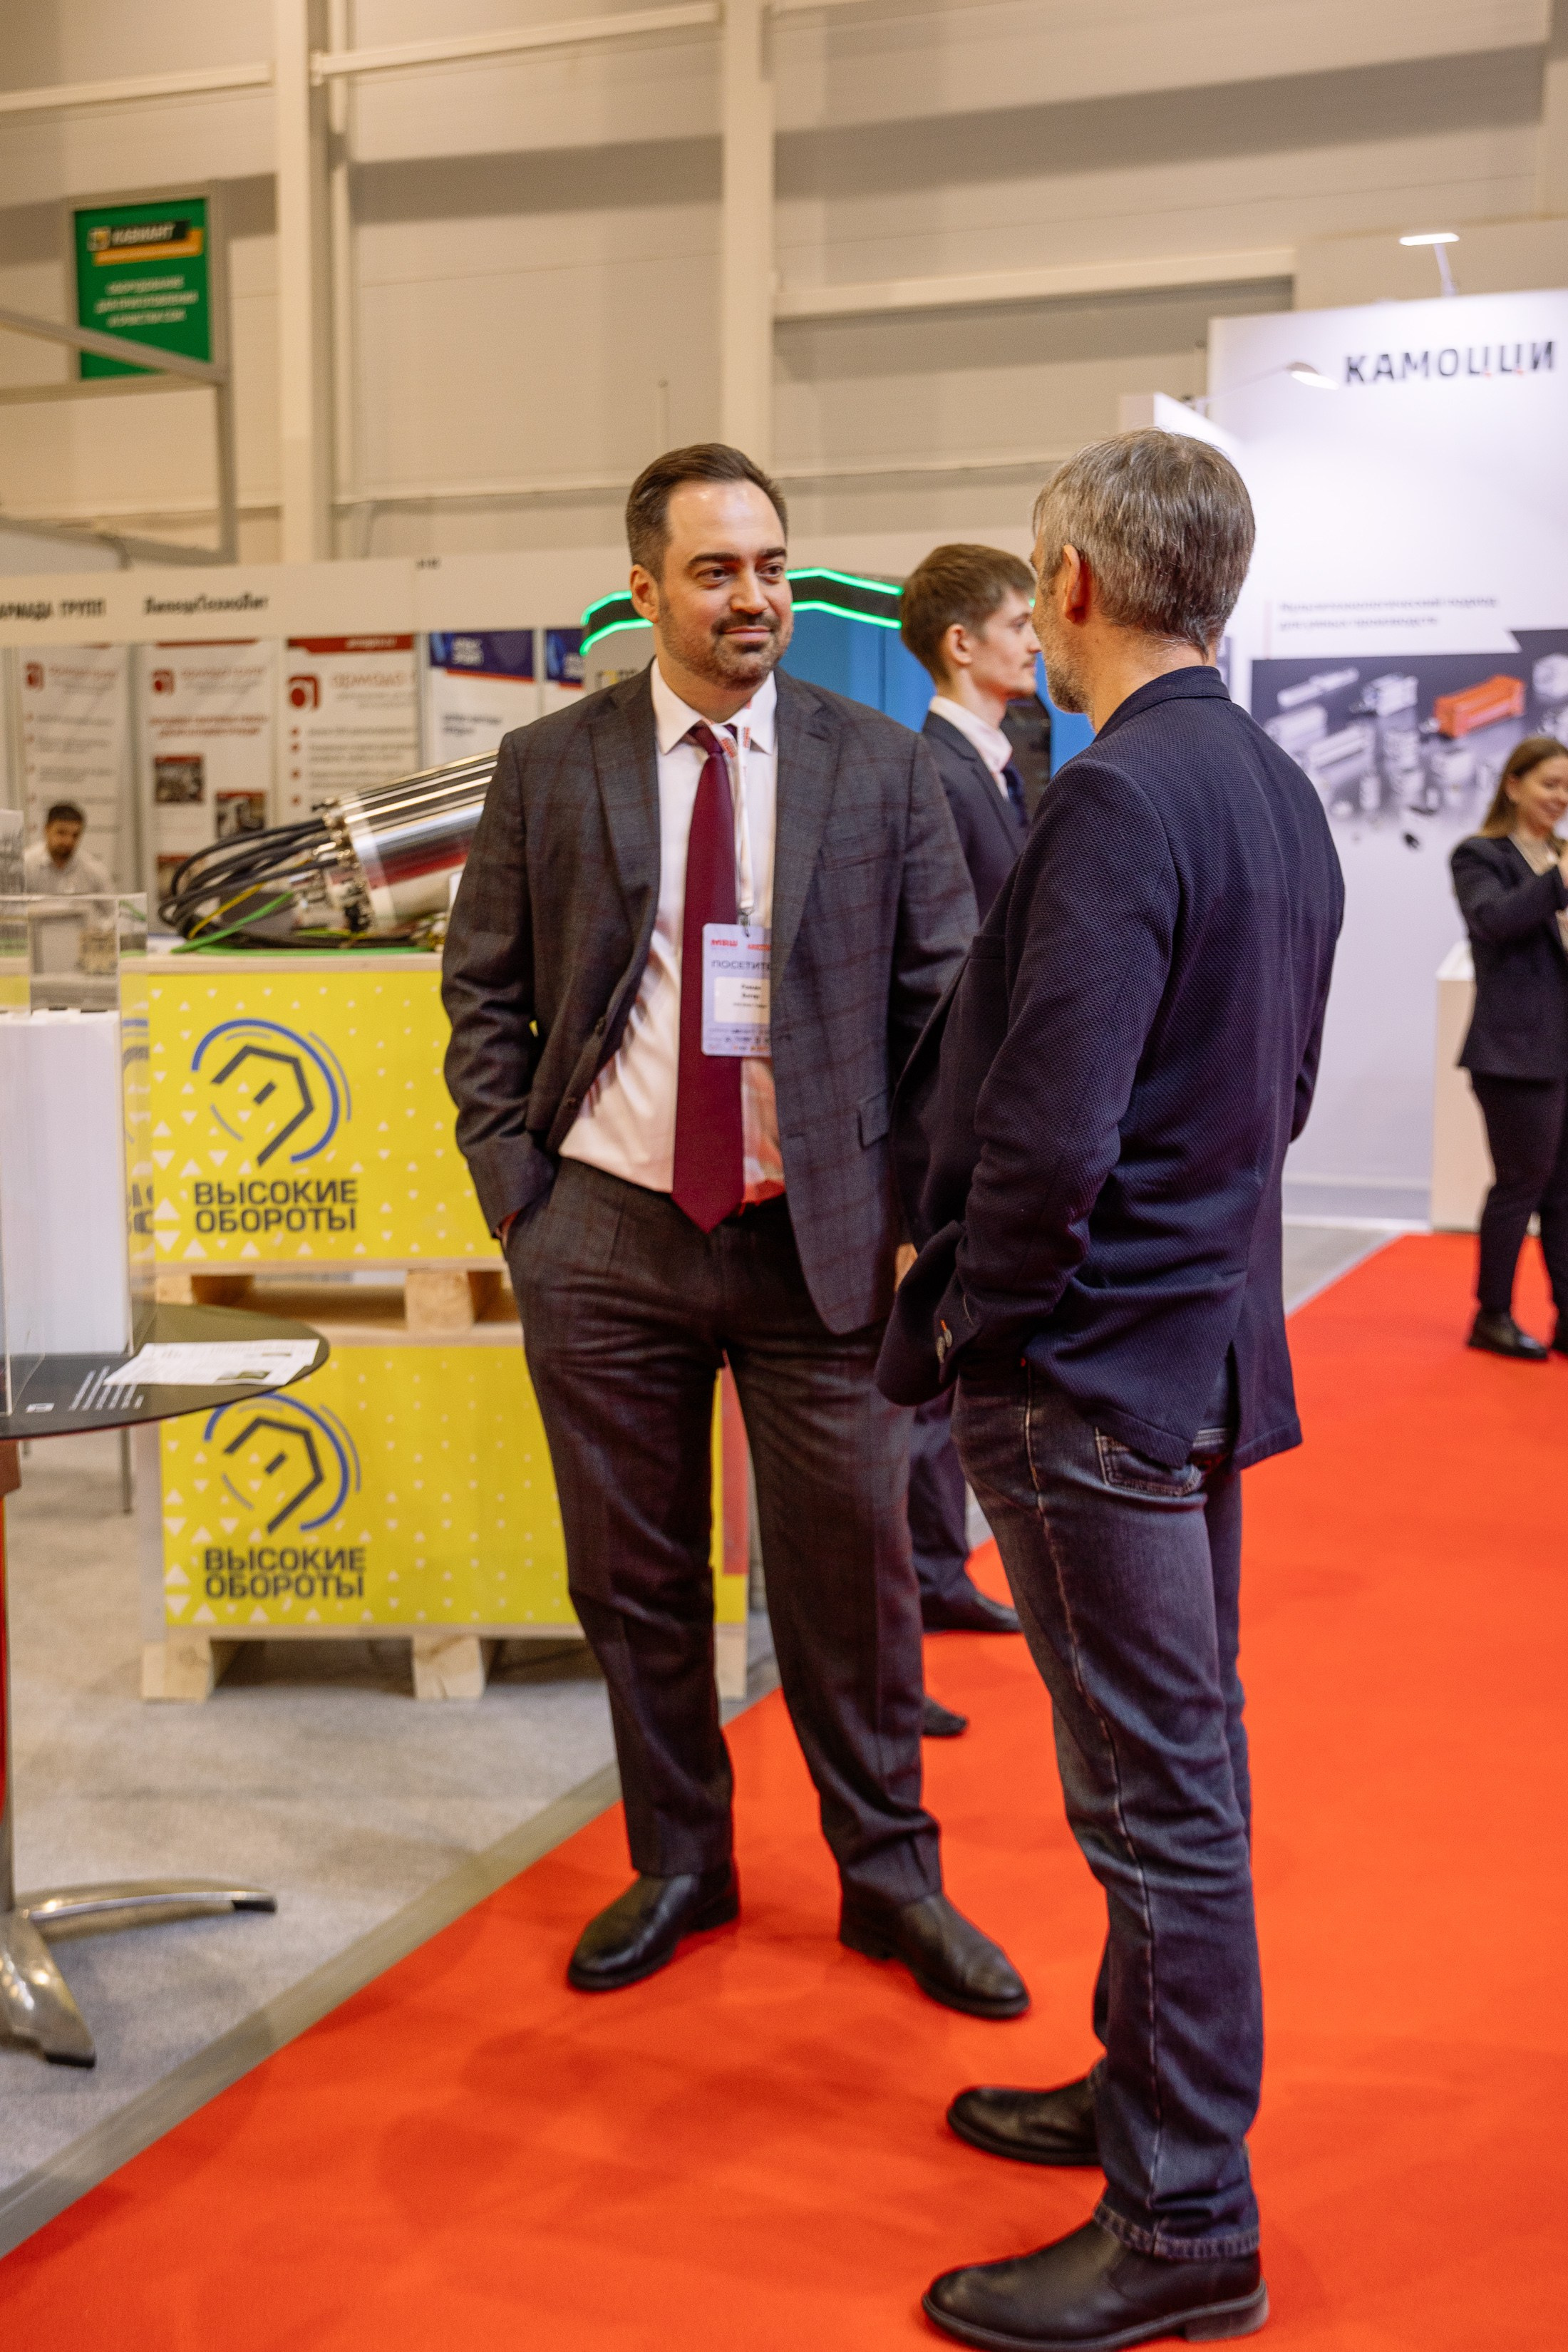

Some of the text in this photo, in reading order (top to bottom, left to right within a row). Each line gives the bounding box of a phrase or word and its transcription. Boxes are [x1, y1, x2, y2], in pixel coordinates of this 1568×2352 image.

[1346, 339, 1556, 383] КАМОЦЦИ
[195, 1180, 357, 1207] ВЫСОКИЕ
[195, 1208, 356, 1234] ОБОРОТЫ
[205, 1548, 366, 1572] ВЫСОКИЕ
[205, 1572, 364, 1598] ОБОРОТЫ
